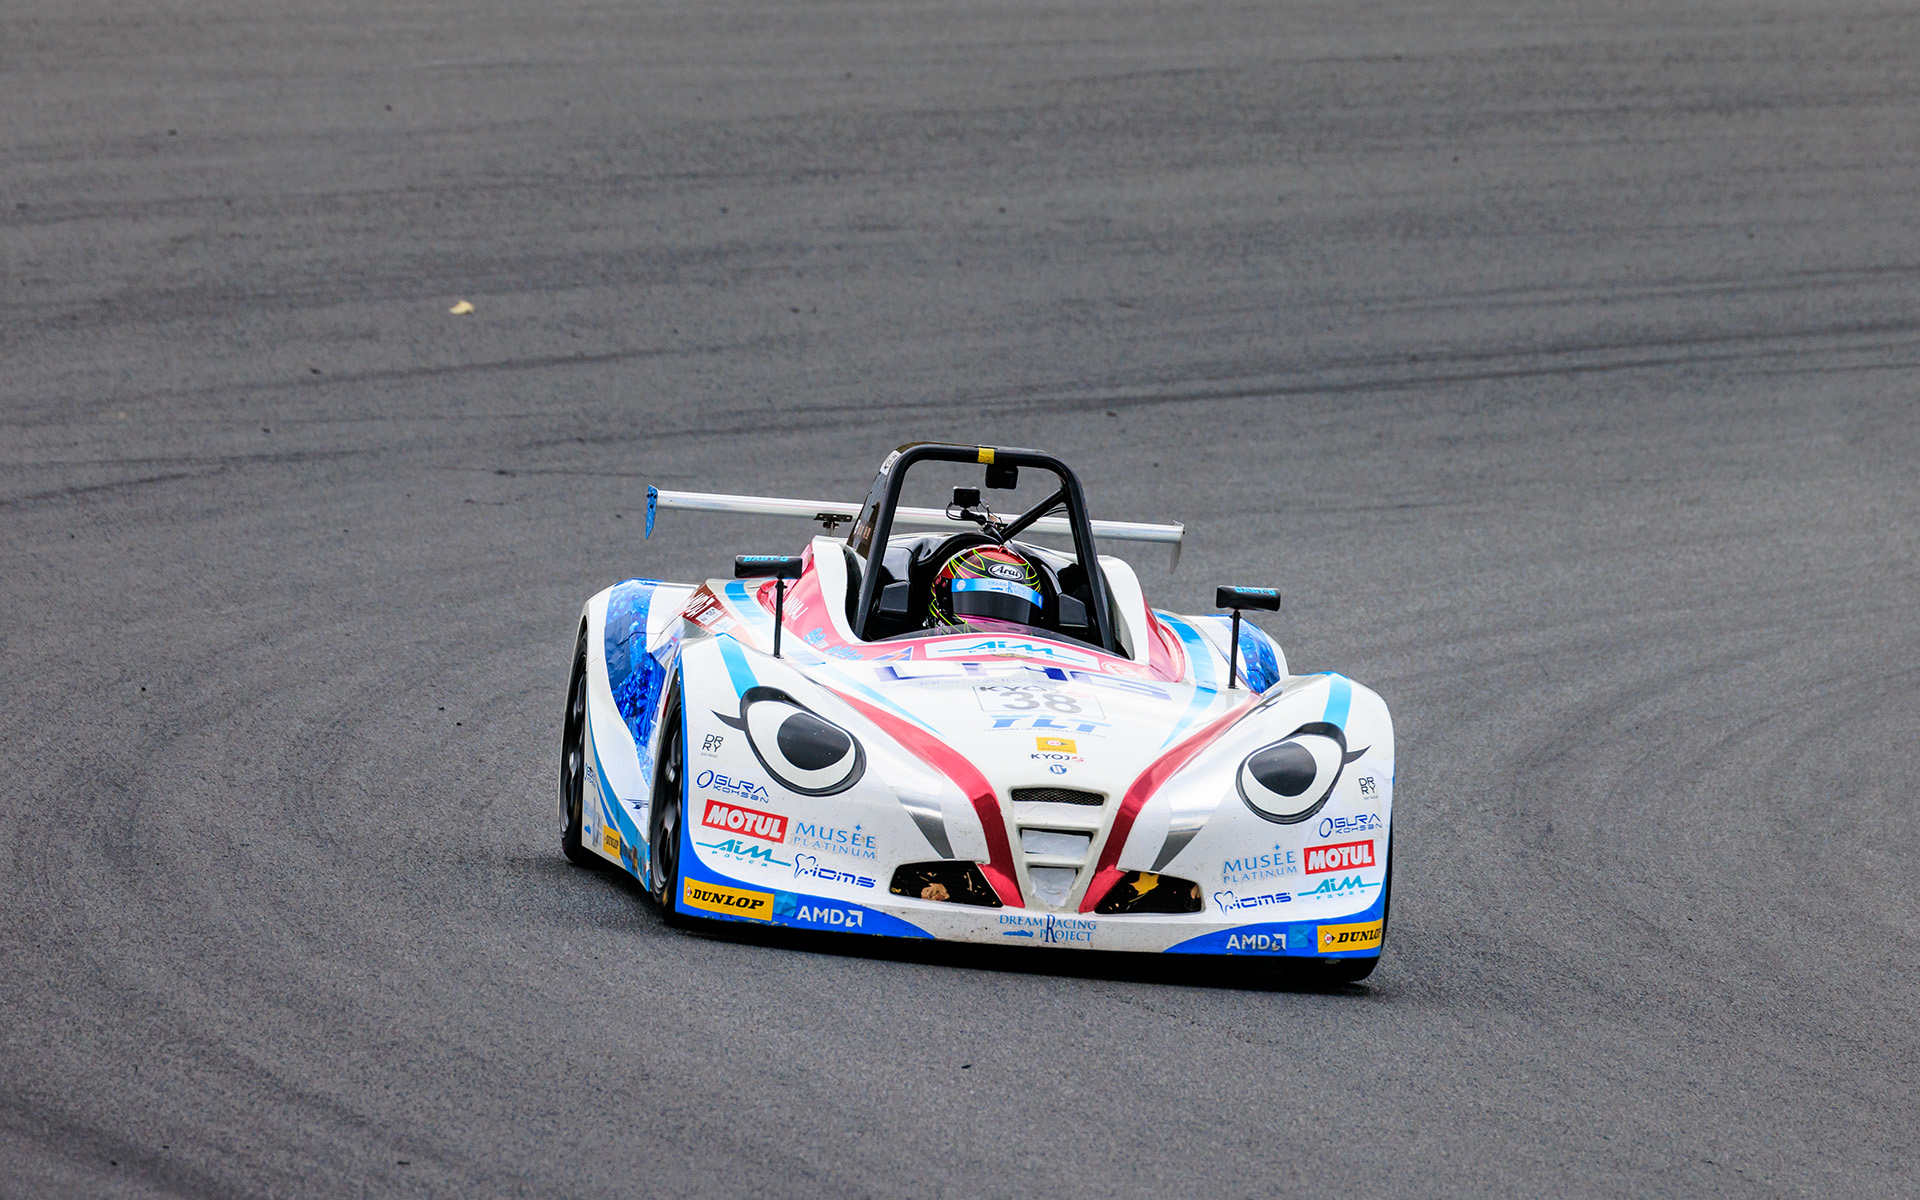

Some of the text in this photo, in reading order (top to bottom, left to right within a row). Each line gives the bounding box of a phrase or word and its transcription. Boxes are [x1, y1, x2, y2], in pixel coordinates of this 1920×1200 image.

[995, 566, 1020, 578] Arai
[999, 691, 1083, 714] 38
[706, 805, 781, 839] MOTUL
[794, 836, 876, 859] PLATINUM
[1308, 844, 1372, 871] MOTUL
[1224, 866, 1297, 884] PLATINUM
[692, 888, 765, 910] DUNLOP
[797, 905, 845, 925] AMD
[1000, 914, 1096, 937] DREAM RACING
[1040, 921, 1093, 943] PROJECT
[1226, 934, 1270, 950] AMD
